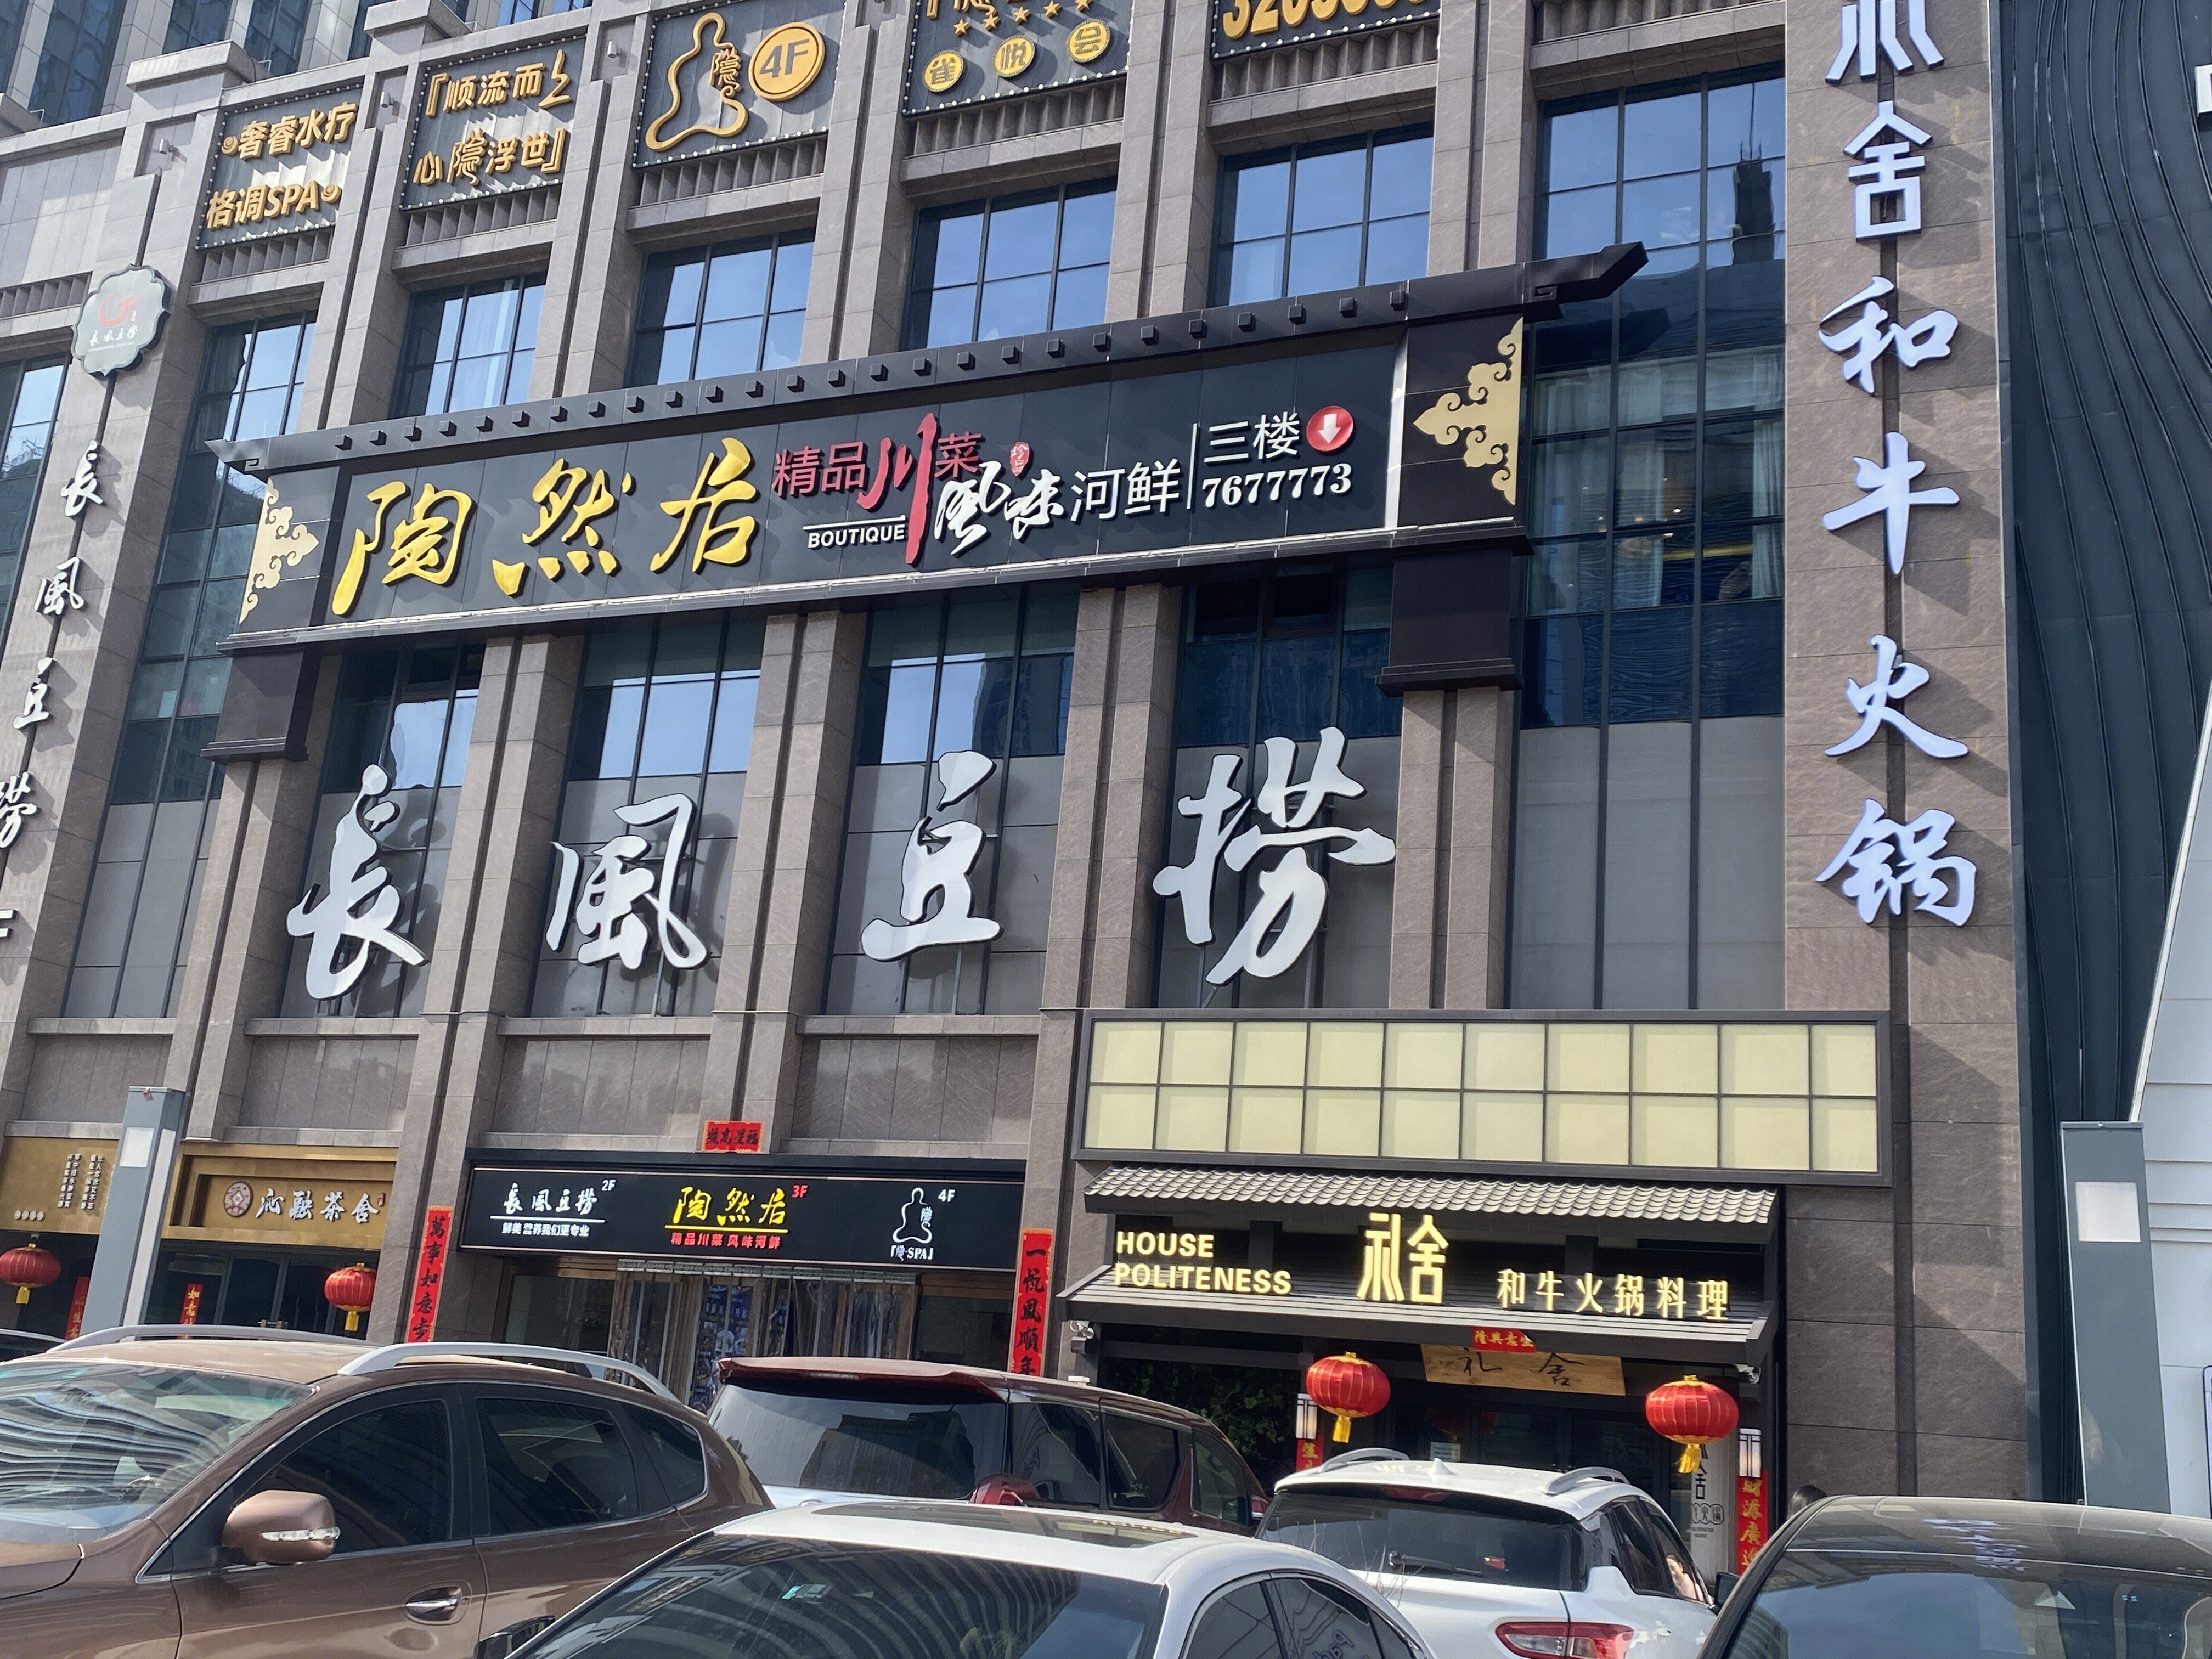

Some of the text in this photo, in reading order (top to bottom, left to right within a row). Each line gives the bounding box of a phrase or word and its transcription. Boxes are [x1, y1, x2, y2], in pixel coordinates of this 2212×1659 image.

[759, 38, 810, 78] 4F
[238, 101, 358, 159] 奢睿水疗
[206, 180, 319, 229] 格调SPA
[1204, 411, 1300, 463] 三楼
[1202, 463, 1352, 507] 7677773
[332, 438, 758, 616] 陶然居
[808, 524, 906, 549] BOUTIQUE
[602, 1180, 616, 1191] 2F
[792, 1184, 808, 1198] 3F
[938, 1189, 955, 1202] 4F
[673, 1186, 786, 1226] 陶然居
[1116, 1231, 1215, 1258] HOUSE
[1114, 1262, 1292, 1294] POLITENESS
[1498, 1268, 1729, 1321] 和牛火锅料理
